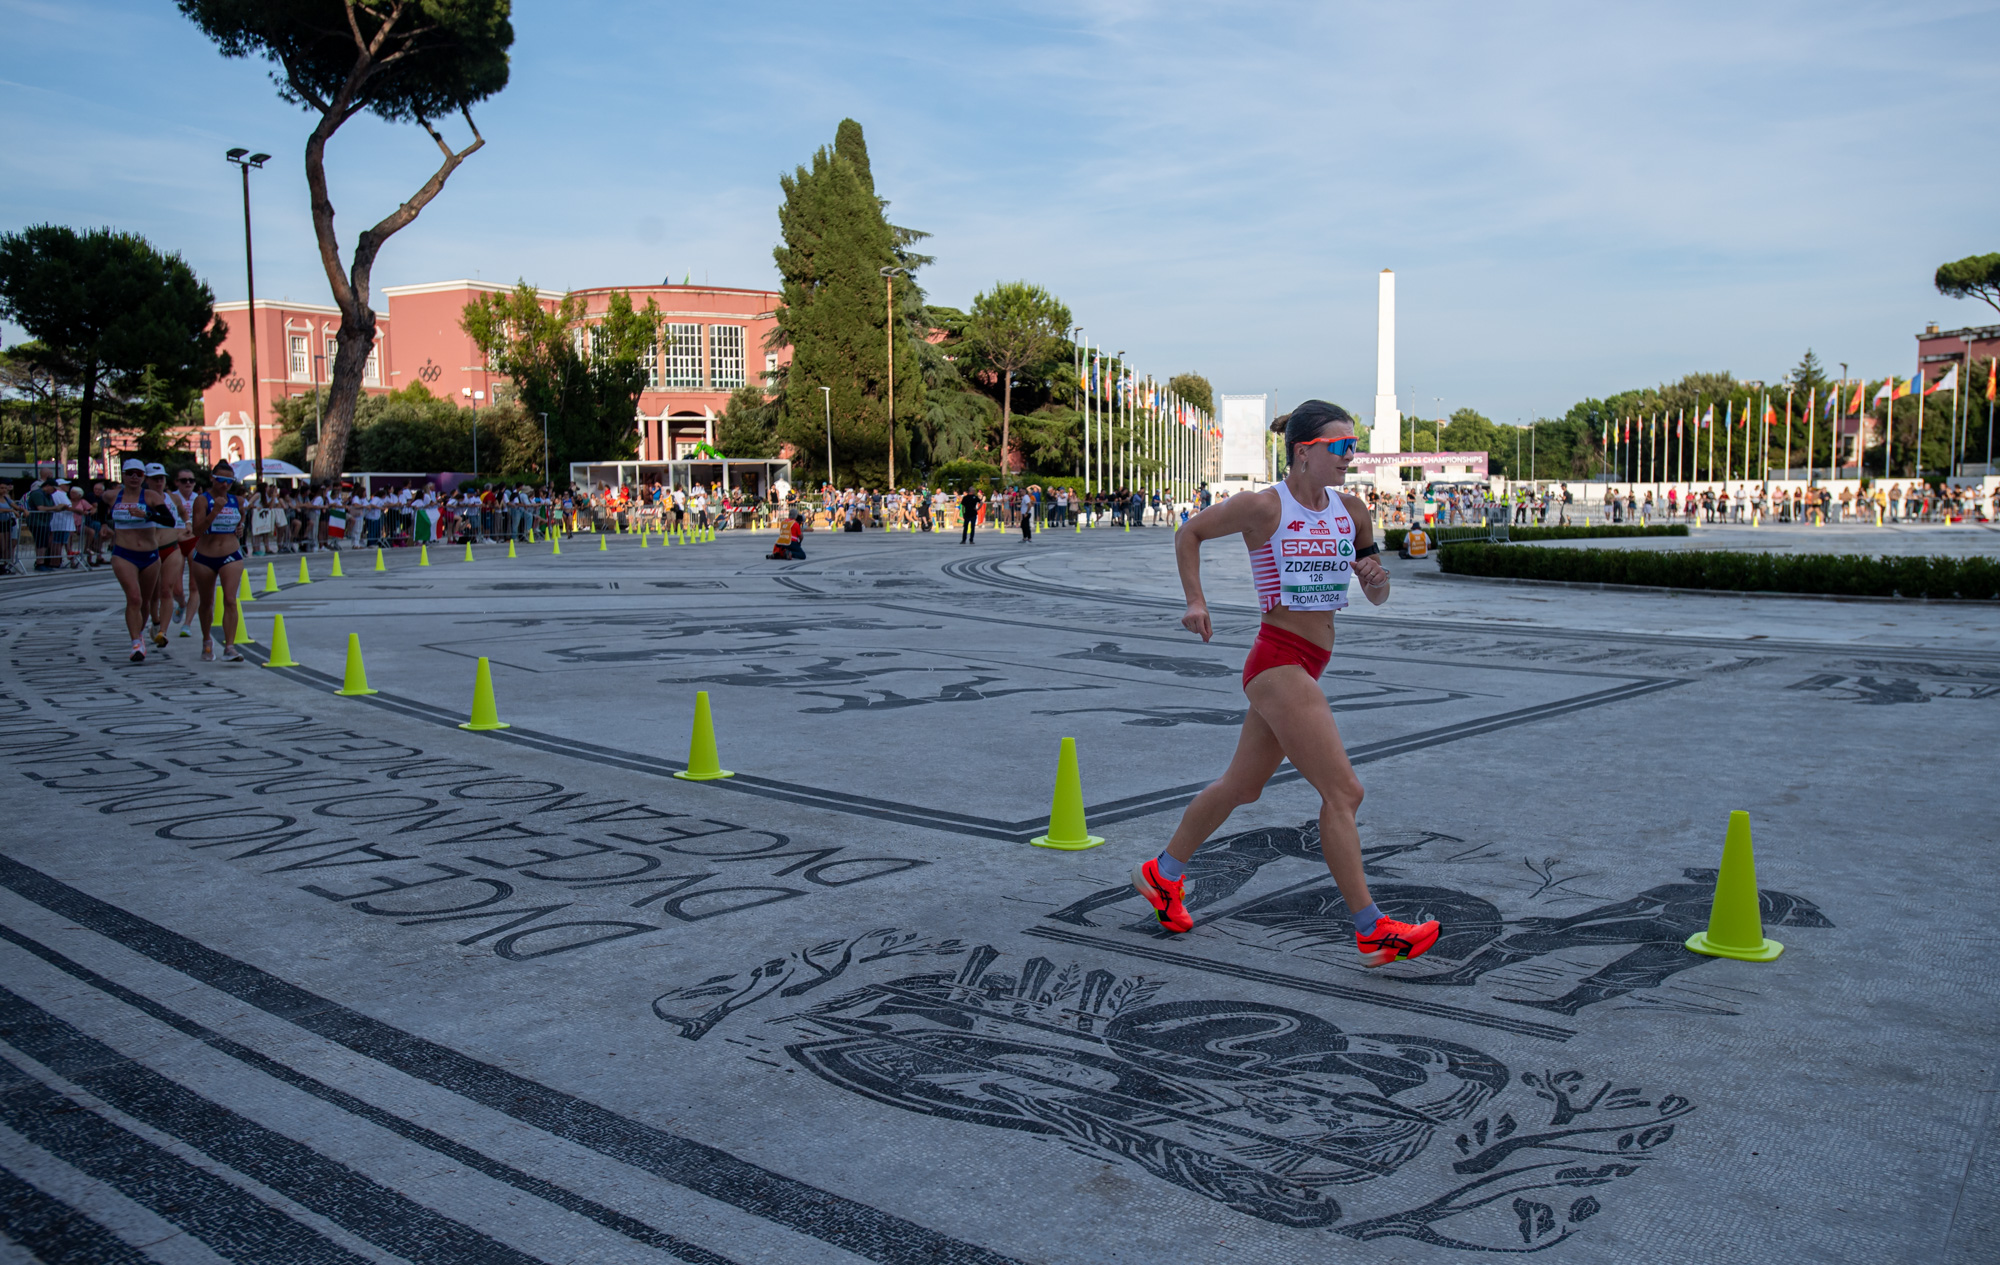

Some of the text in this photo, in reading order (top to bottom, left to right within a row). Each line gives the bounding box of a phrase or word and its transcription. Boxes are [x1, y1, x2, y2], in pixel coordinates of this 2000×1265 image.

[1351, 456, 1483, 465] ROPEAN ATHLETICS CHAMPIONSHIPS
[1287, 520, 1305, 532] 4F
[1284, 541, 1336, 554] SPAR
[1285, 560, 1348, 573] ZDZIEBŁO
[1309, 573, 1324, 582] 126
[1316, 584, 1334, 592] CLEAN
[1292, 593, 1340, 604] ROMA 2024
